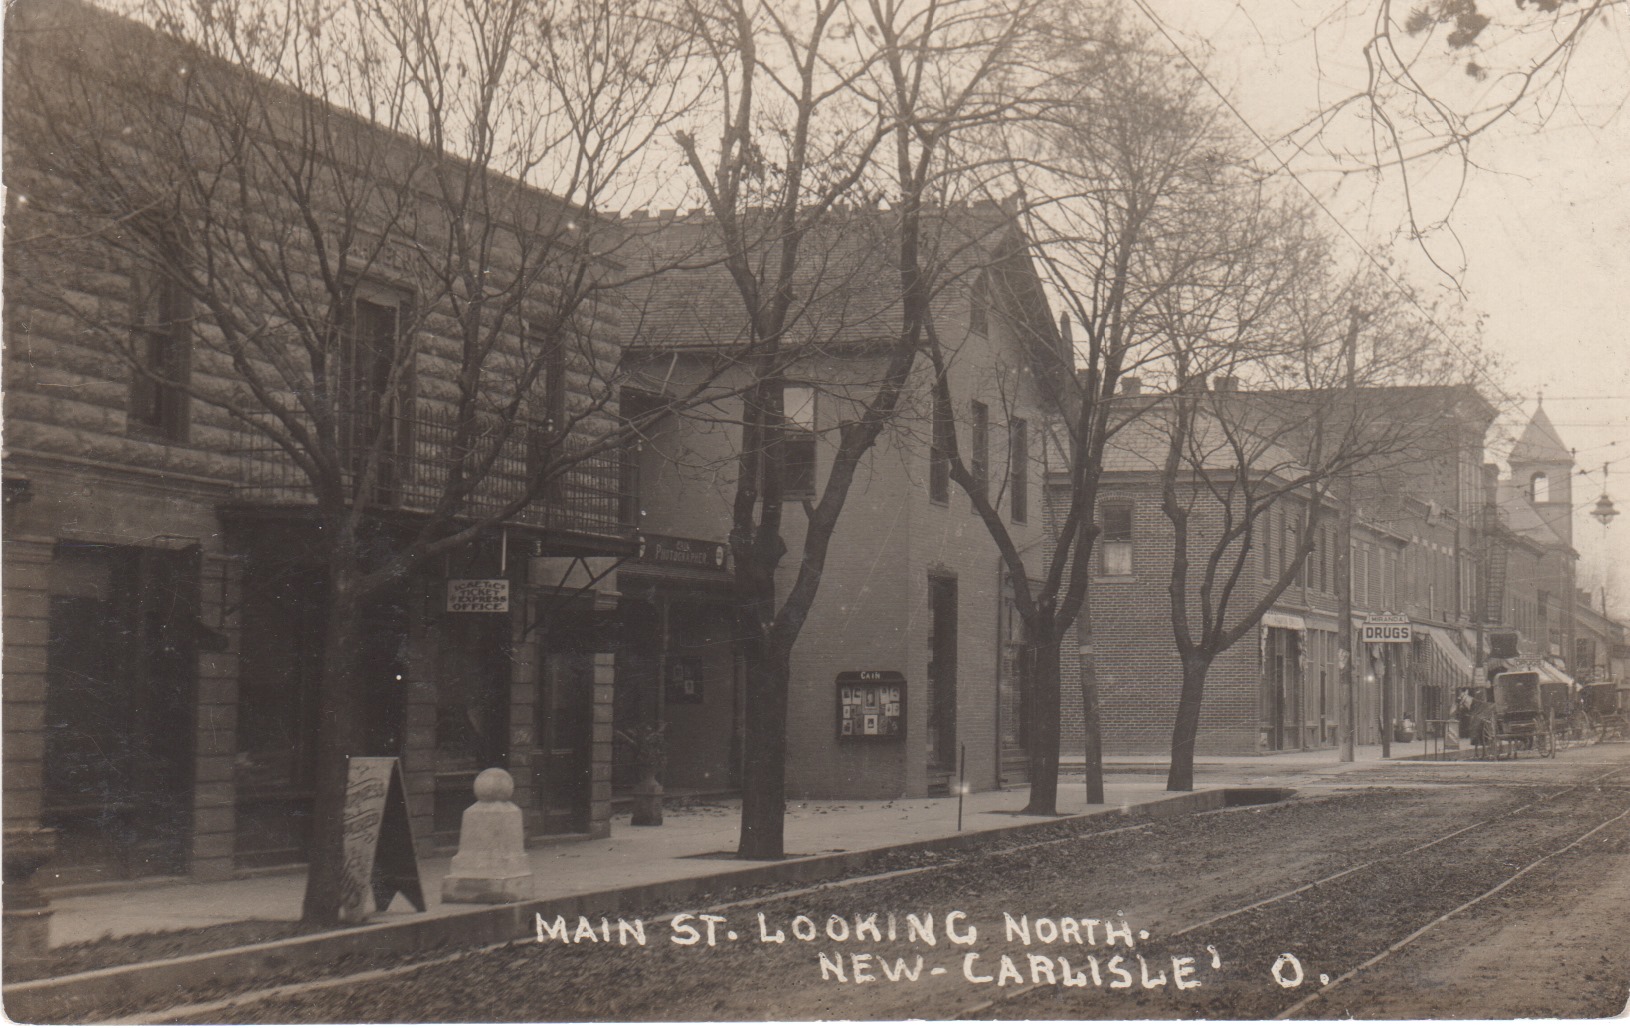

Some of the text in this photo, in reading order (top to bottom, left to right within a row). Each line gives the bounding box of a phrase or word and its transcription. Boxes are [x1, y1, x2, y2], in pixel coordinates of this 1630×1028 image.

[655, 543, 707, 564] PHOTOGRAPHER
[460, 588, 499, 596] TICKET
[1367, 627, 1408, 638] DRUGS
[860, 671, 881, 680] CAIN
